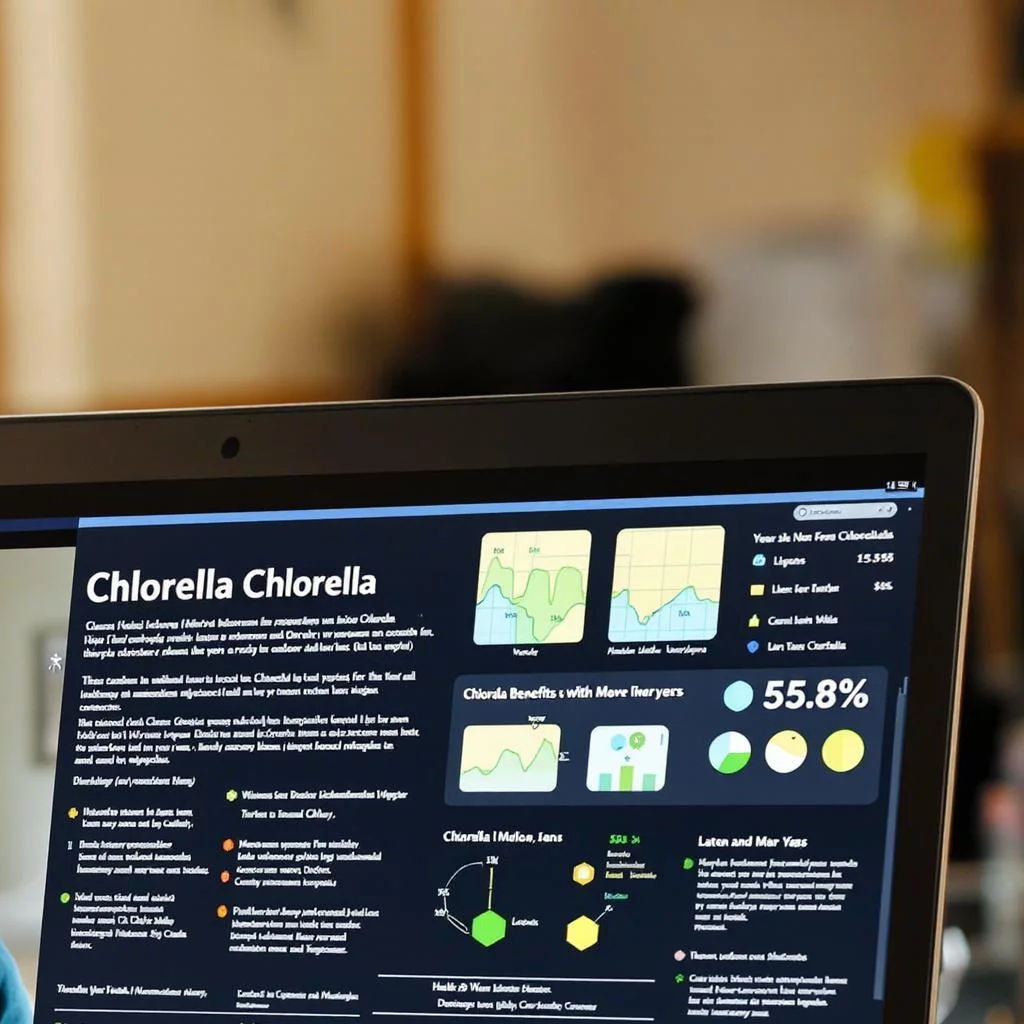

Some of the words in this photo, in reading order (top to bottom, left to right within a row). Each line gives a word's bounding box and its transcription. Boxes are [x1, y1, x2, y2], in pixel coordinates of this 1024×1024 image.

[86, 567, 233, 603] Chlorella
[242, 565, 377, 599] Chlorella
[762, 677, 870, 710] 55.8%
[731, 836, 752, 847] and
